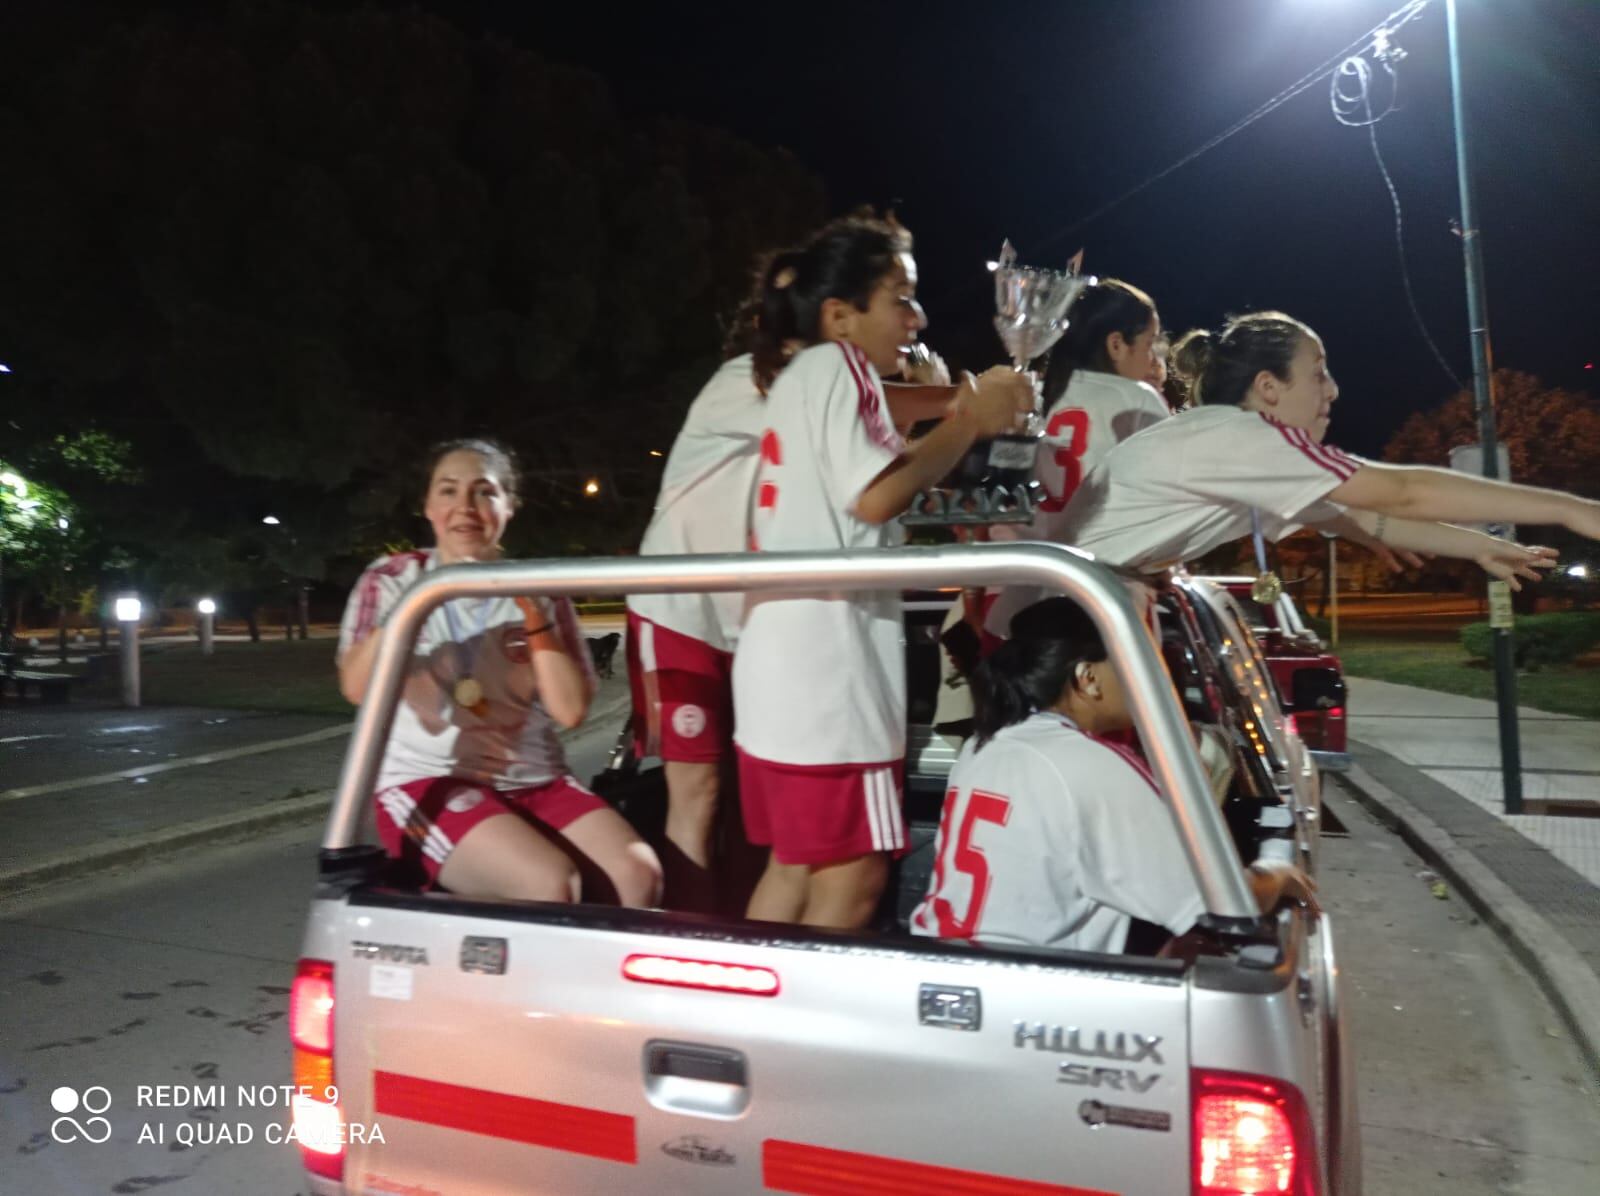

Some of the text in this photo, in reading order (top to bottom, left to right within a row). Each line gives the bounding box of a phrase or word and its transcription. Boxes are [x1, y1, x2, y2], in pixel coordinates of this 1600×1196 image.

[1040, 407, 1089, 513] 3
[1013, 1019, 1165, 1065] HILUX
[1056, 1060, 1161, 1093] SRV
